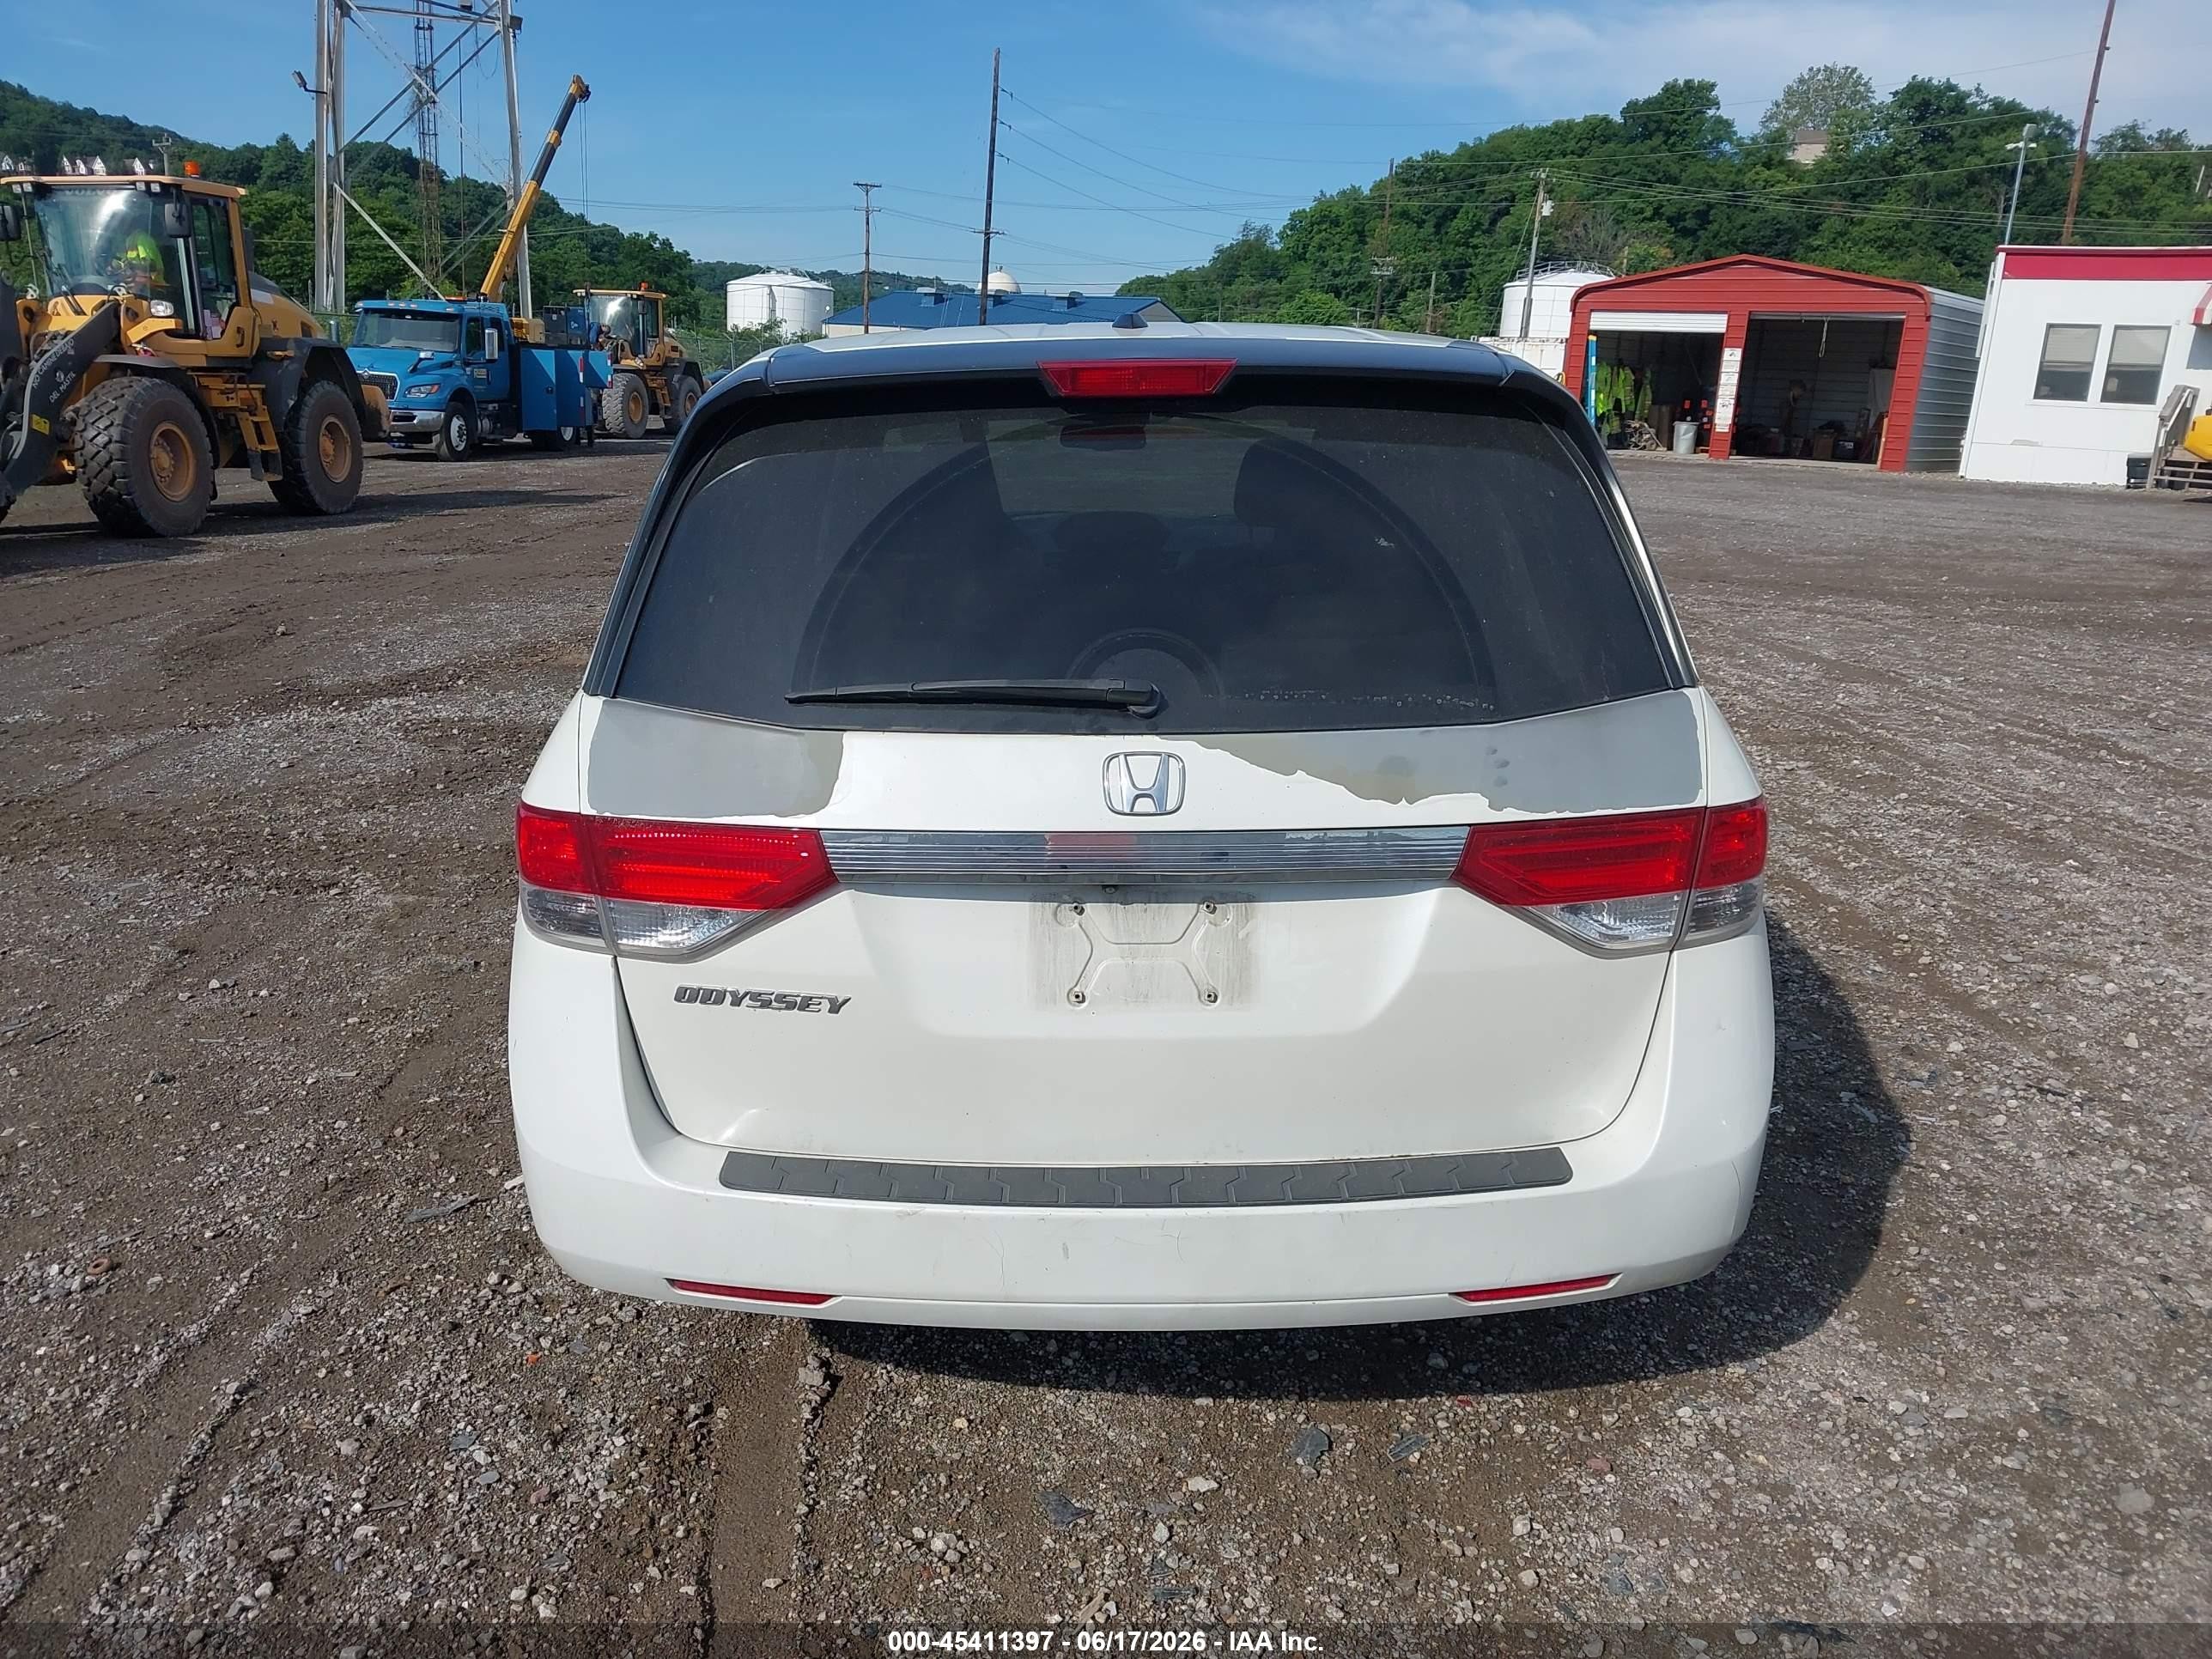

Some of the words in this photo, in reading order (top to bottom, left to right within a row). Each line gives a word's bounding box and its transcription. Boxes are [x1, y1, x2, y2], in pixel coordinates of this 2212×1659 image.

[33, 374, 40, 389] NO
[49, 391, 60, 403] DEL
[59, 371, 76, 392] MASTIL
[674, 985, 852, 1015] ODYSSEY
